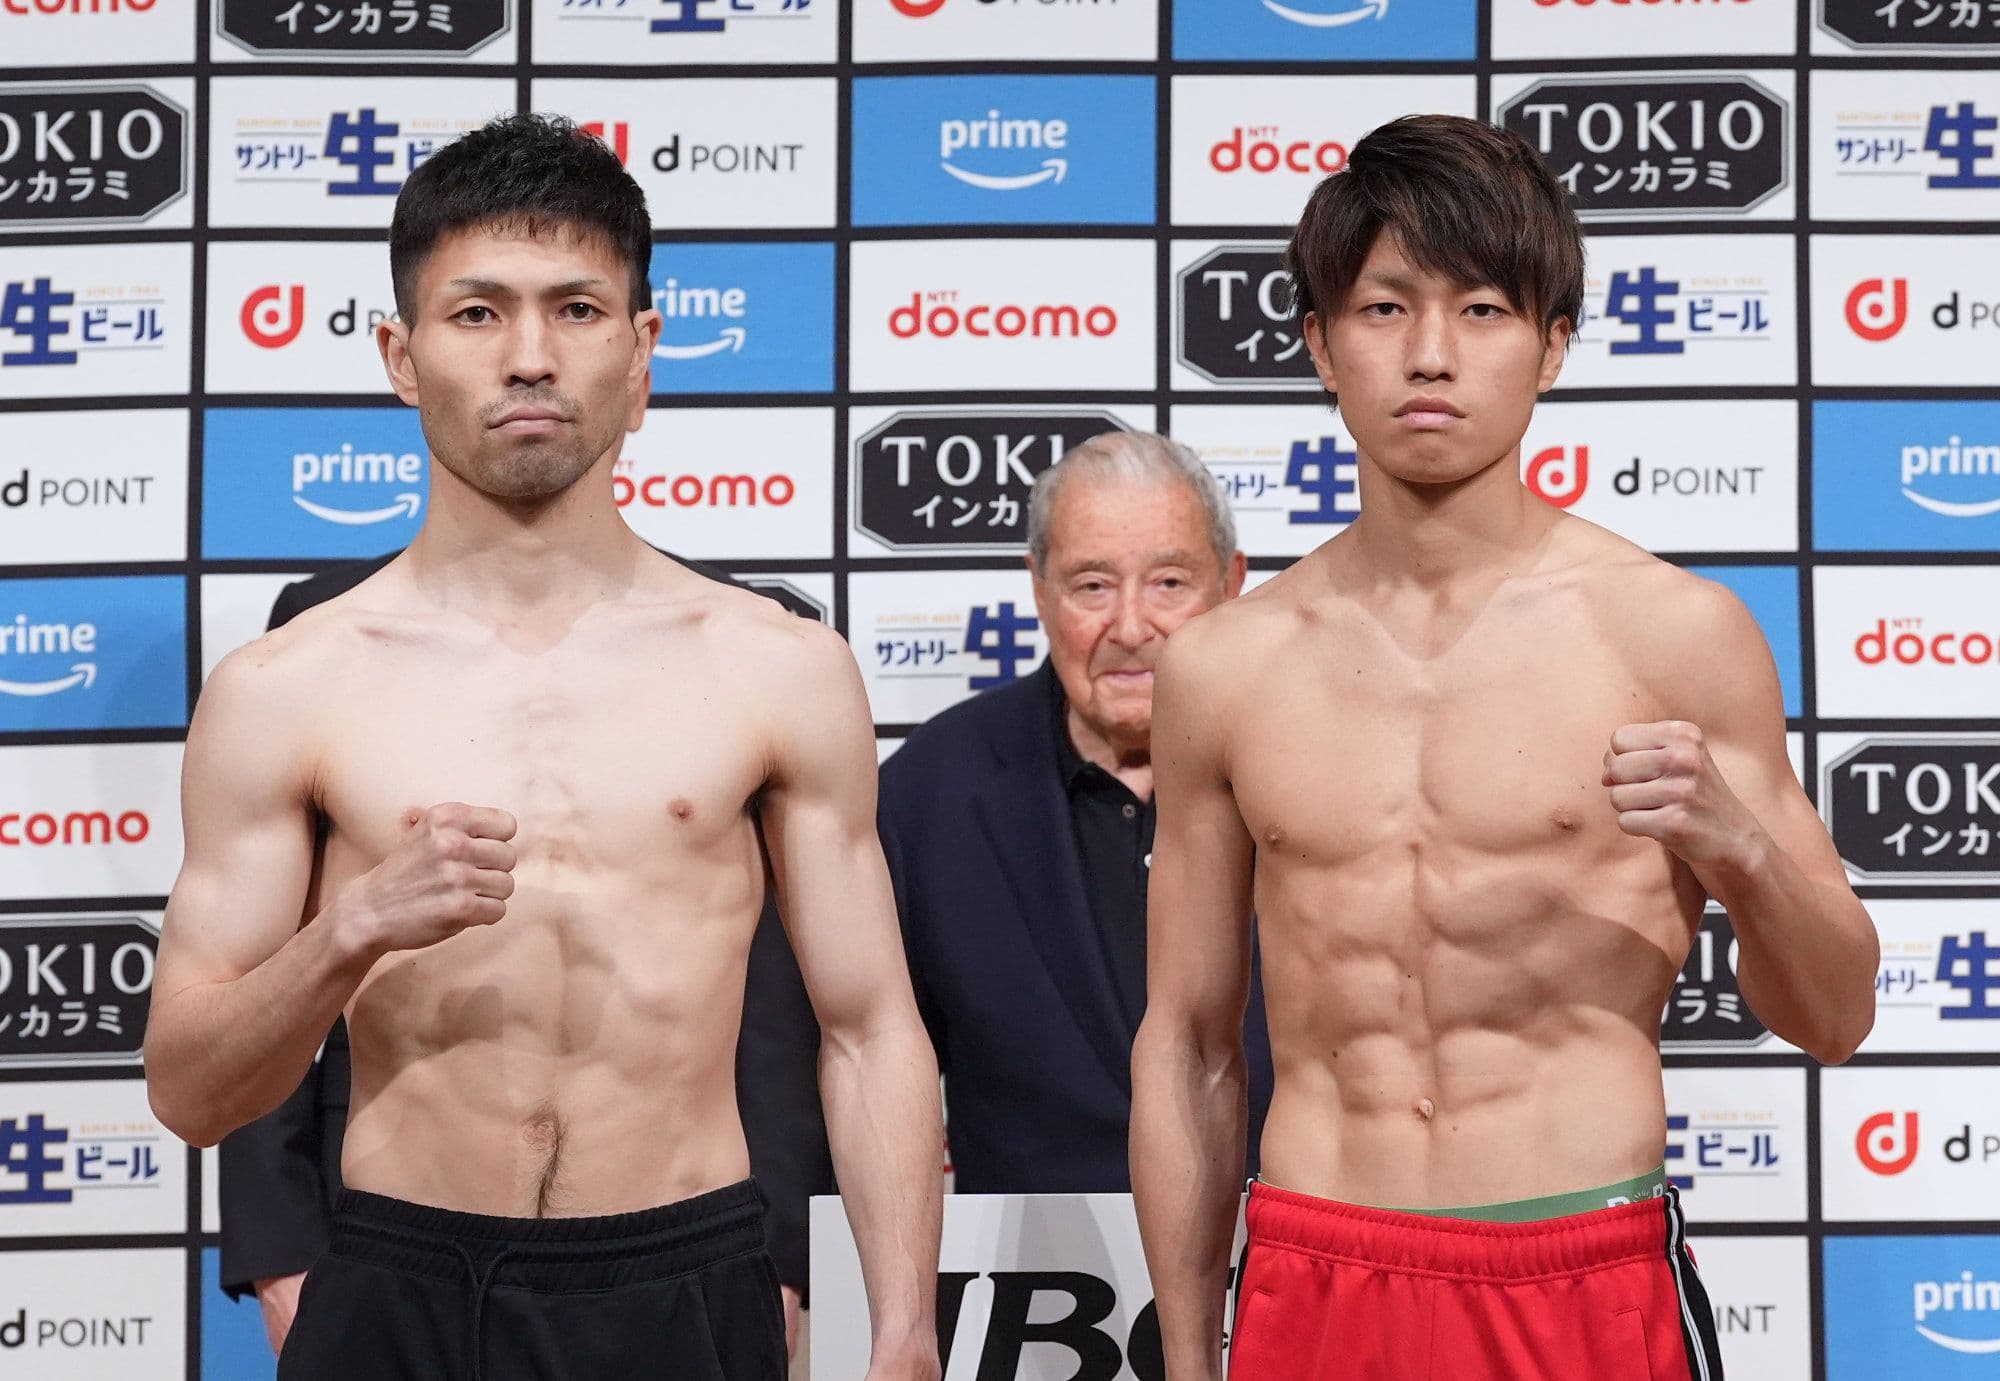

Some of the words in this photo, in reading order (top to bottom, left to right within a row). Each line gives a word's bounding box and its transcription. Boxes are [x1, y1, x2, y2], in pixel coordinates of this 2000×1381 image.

[275, 1, 454, 34] インカラミ
[941, 110, 1068, 158] prime
[1523, 100, 1764, 153] TOKIO
[653, 134, 680, 172] d
[691, 144, 804, 172] POINT
[1557, 157, 1733, 194] インカラミ
[328, 298, 356, 337] d
[888, 291, 1118, 338] docomo
[1932, 291, 1959, 330] d
[292, 443, 422, 492] prime
[1613, 457, 1640, 496] d
[1652, 467, 1765, 496] POINT
[1, 469, 29, 508] d
[40, 477, 154, 507] POINT
[1854, 618, 2000, 665] doco
[1882, 822, 2000, 857] インカ
[0, 942, 155, 996] KIO
[1943, 1124, 1970, 1163] d
[39, 1318, 152, 1348] POINT
